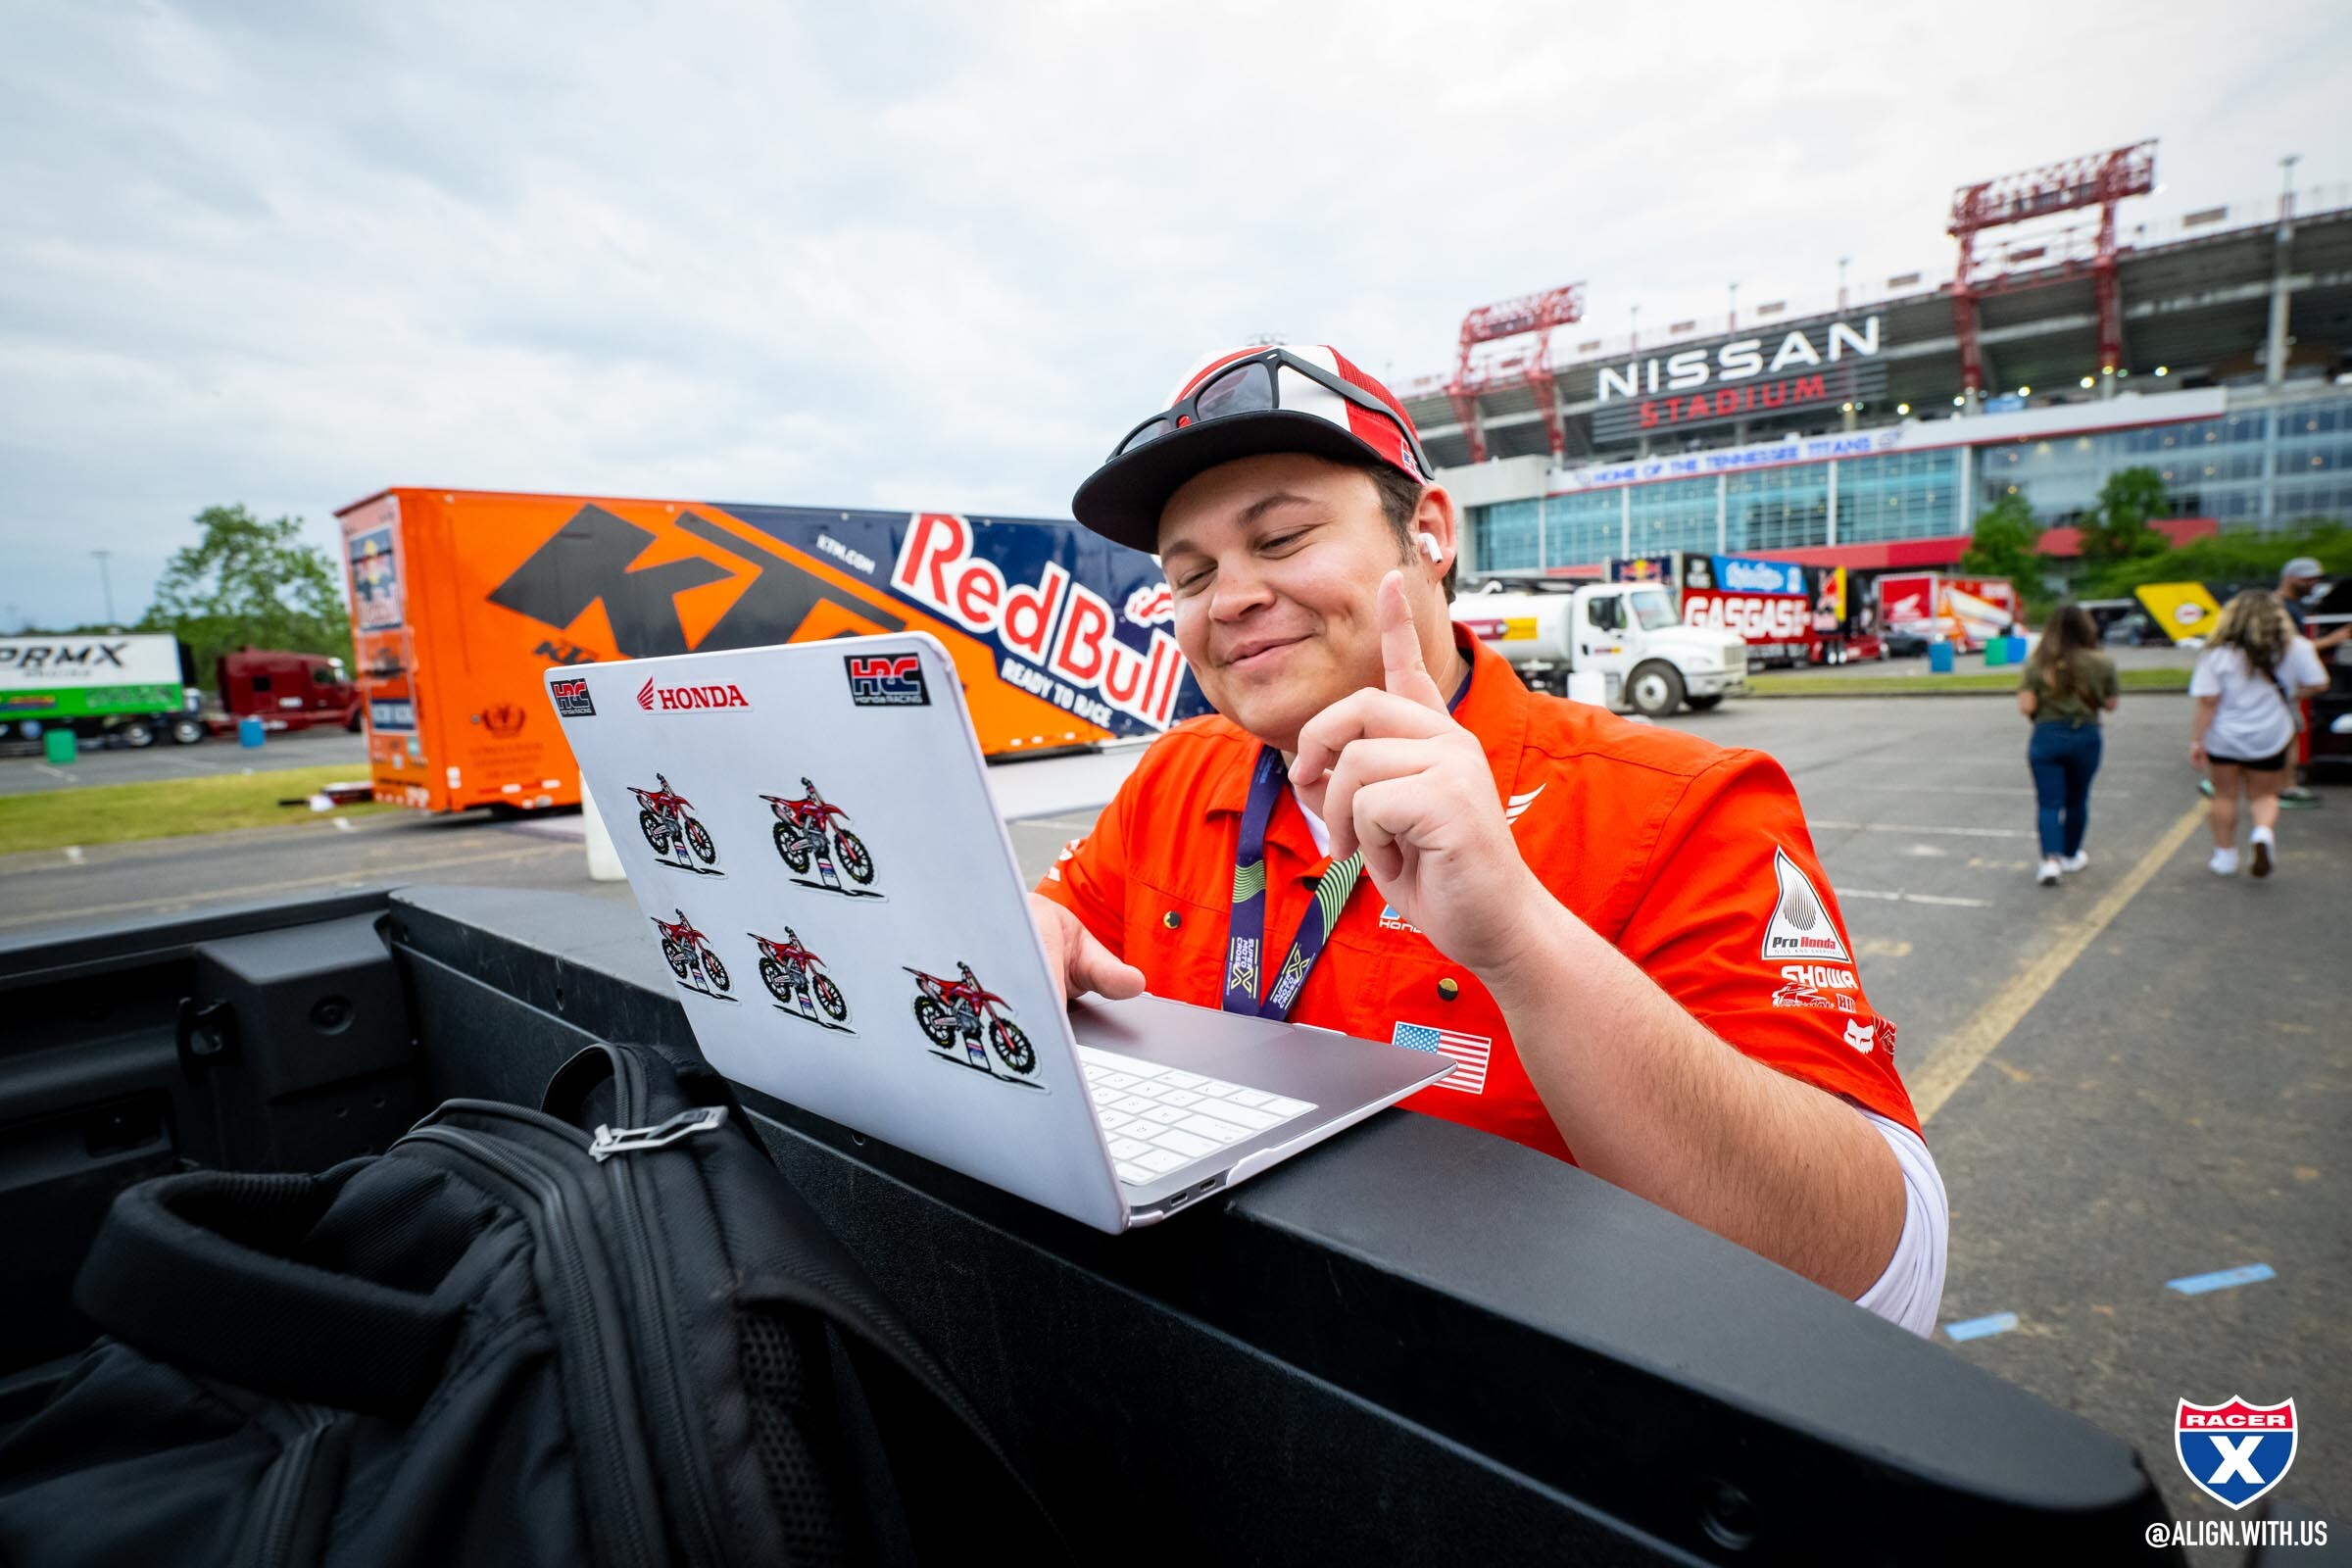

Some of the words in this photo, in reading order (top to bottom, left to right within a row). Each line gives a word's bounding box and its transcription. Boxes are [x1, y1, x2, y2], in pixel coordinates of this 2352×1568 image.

[1598, 317, 1880, 402] NISSAN
[1639, 374, 1826, 429] STADIUM
[894, 512, 1066, 662] Red
[1053, 588, 1184, 726] Bull
[1685, 596, 1794, 638] GASGAS
[851, 657, 920, 696] HRC
[1001, 658, 1054, 699] READY
[1054, 682, 1075, 710] TO
[1073, 694, 1113, 728] RACE
[658, 685, 749, 710] HONDA
[1772, 937, 1798, 948] Pro
[1800, 937, 1836, 950] Honda
[1273, 972, 1291, 1004] SUPER
[1278, 976, 1294, 1004] MOTO
[1279, 979, 1298, 1008] CROSS
[1781, 965, 1858, 990] SHOWA
